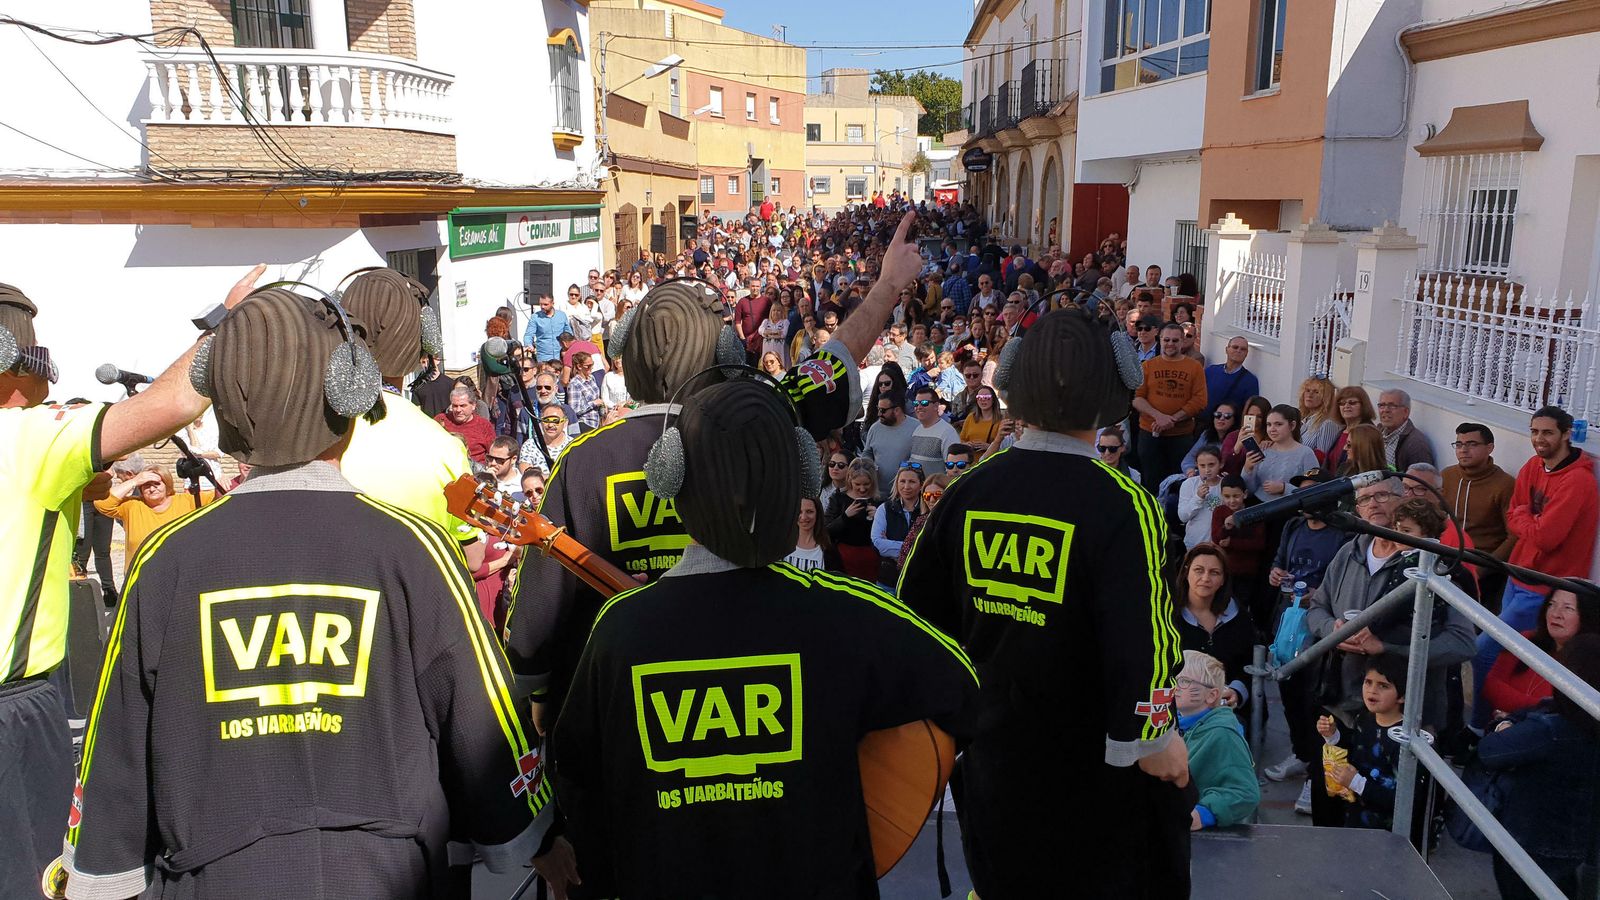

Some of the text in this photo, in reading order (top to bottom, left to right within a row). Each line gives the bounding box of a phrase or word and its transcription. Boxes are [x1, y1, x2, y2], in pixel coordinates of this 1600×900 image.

[459, 226, 487, 247] Estamos
[530, 222, 561, 241] COVIRAN
[1360, 274, 1369, 289] 19
[1154, 369, 1189, 382] DIESEL
[621, 490, 683, 528] VA
[626, 558, 648, 571] LOS
[974, 531, 1054, 578] VAR
[219, 612, 352, 671] VAR
[650, 683, 785, 743] VAR
[1153, 704, 1168, 712] VA
[220, 718, 253, 740] LOS
[684, 777, 784, 804] VARBATEÑOS
